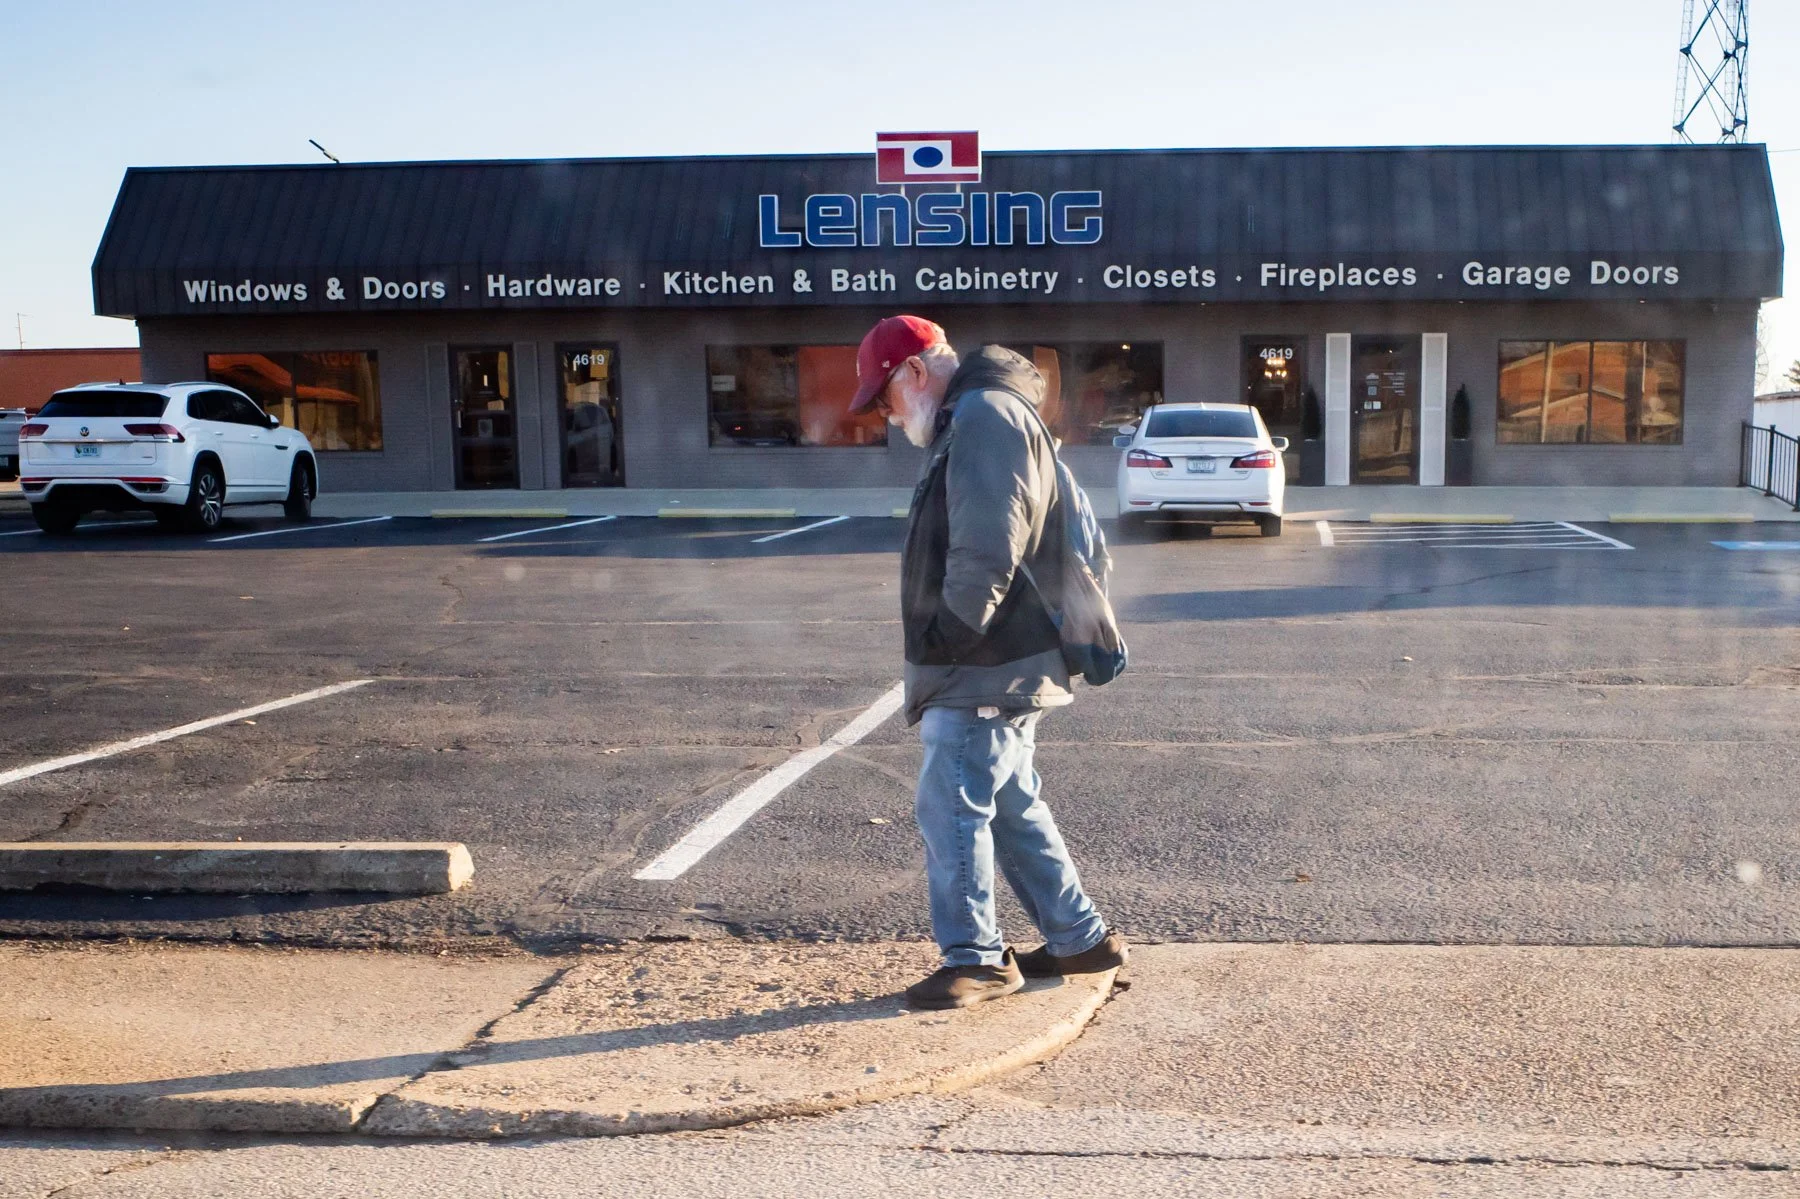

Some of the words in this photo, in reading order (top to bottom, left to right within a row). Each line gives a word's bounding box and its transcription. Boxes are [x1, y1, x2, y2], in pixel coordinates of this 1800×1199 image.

[184, 280, 307, 303] Windows
[327, 278, 345, 300] &
[364, 277, 445, 300] Doors
[488, 273, 620, 298] Hardware
[664, 271, 774, 295] Kitchen
[793, 269, 812, 292] &
[832, 268, 895, 292] Bath
[916, 267, 1058, 294] Cabinetry
[1103, 265, 1216, 289] Closets
[1261, 263, 1417, 291] Fireplaces
[1462, 262, 1570, 290] Garage
[1590, 260, 1679, 285] Doors
[1259, 347, 1293, 359] 4619
[574, 354, 605, 366] 4619
